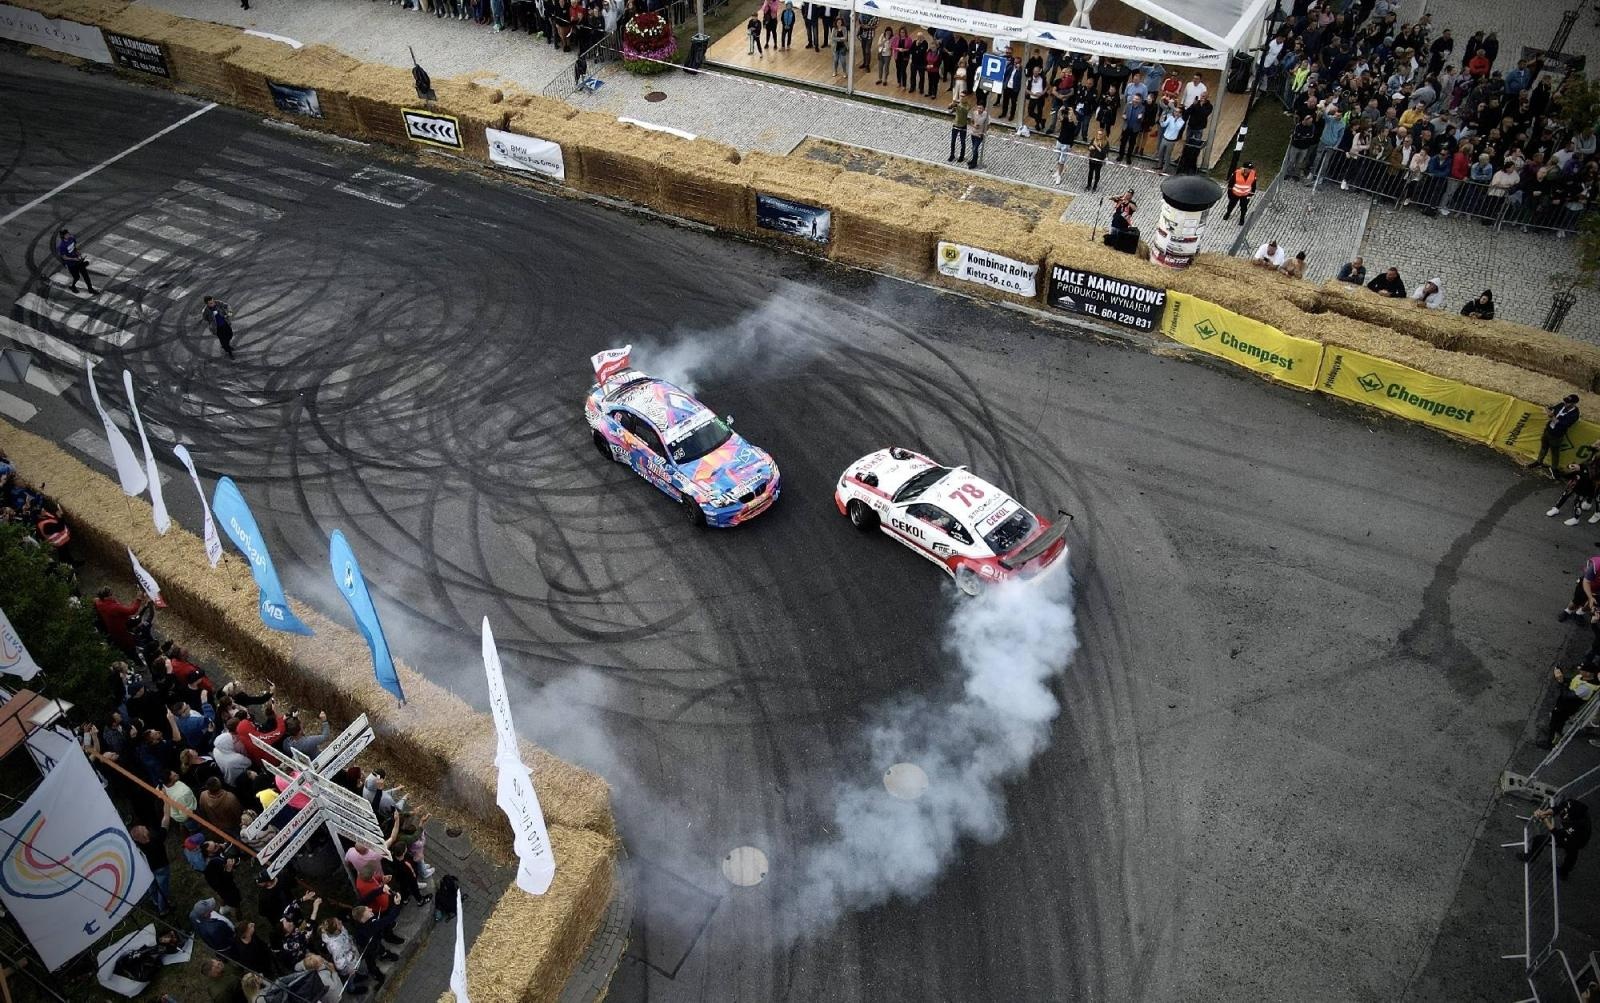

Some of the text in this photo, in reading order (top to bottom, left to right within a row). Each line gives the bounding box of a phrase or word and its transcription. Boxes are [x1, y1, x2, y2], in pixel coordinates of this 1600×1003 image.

[986, 57, 1001, 76] P
[510, 144, 528, 155] BMW
[540, 159, 560, 169] Group
[966, 266, 988, 281] Kietrz
[989, 273, 1000, 285] Sp.
[1006, 281, 1014, 289] o.
[1014, 282, 1022, 290] o.
[967, 252, 1008, 273] Kombinat
[1009, 265, 1034, 281] Rolny
[1053, 266, 1165, 305] HALE NAMIOTOWE
[1110, 295, 1151, 313] WYNAJEM
[1084, 303, 1100, 316] TEL.
[1101, 308, 1117, 320] 604
[1118, 313, 1135, 325] 229
[1135, 318, 1152, 329] 831
[1220, 331, 1295, 370] Chempest
[1386, 383, 1475, 422] Chempest
[948, 483, 984, 508] 78
[986, 507, 1010, 526] CEKOL
[891, 518, 926, 541] CEKOL
[332, 731, 353, 752] Rynek
[279, 787, 295, 805] Maja
[269, 826, 292, 852] Urząd
[291, 801, 318, 829] Miejski
